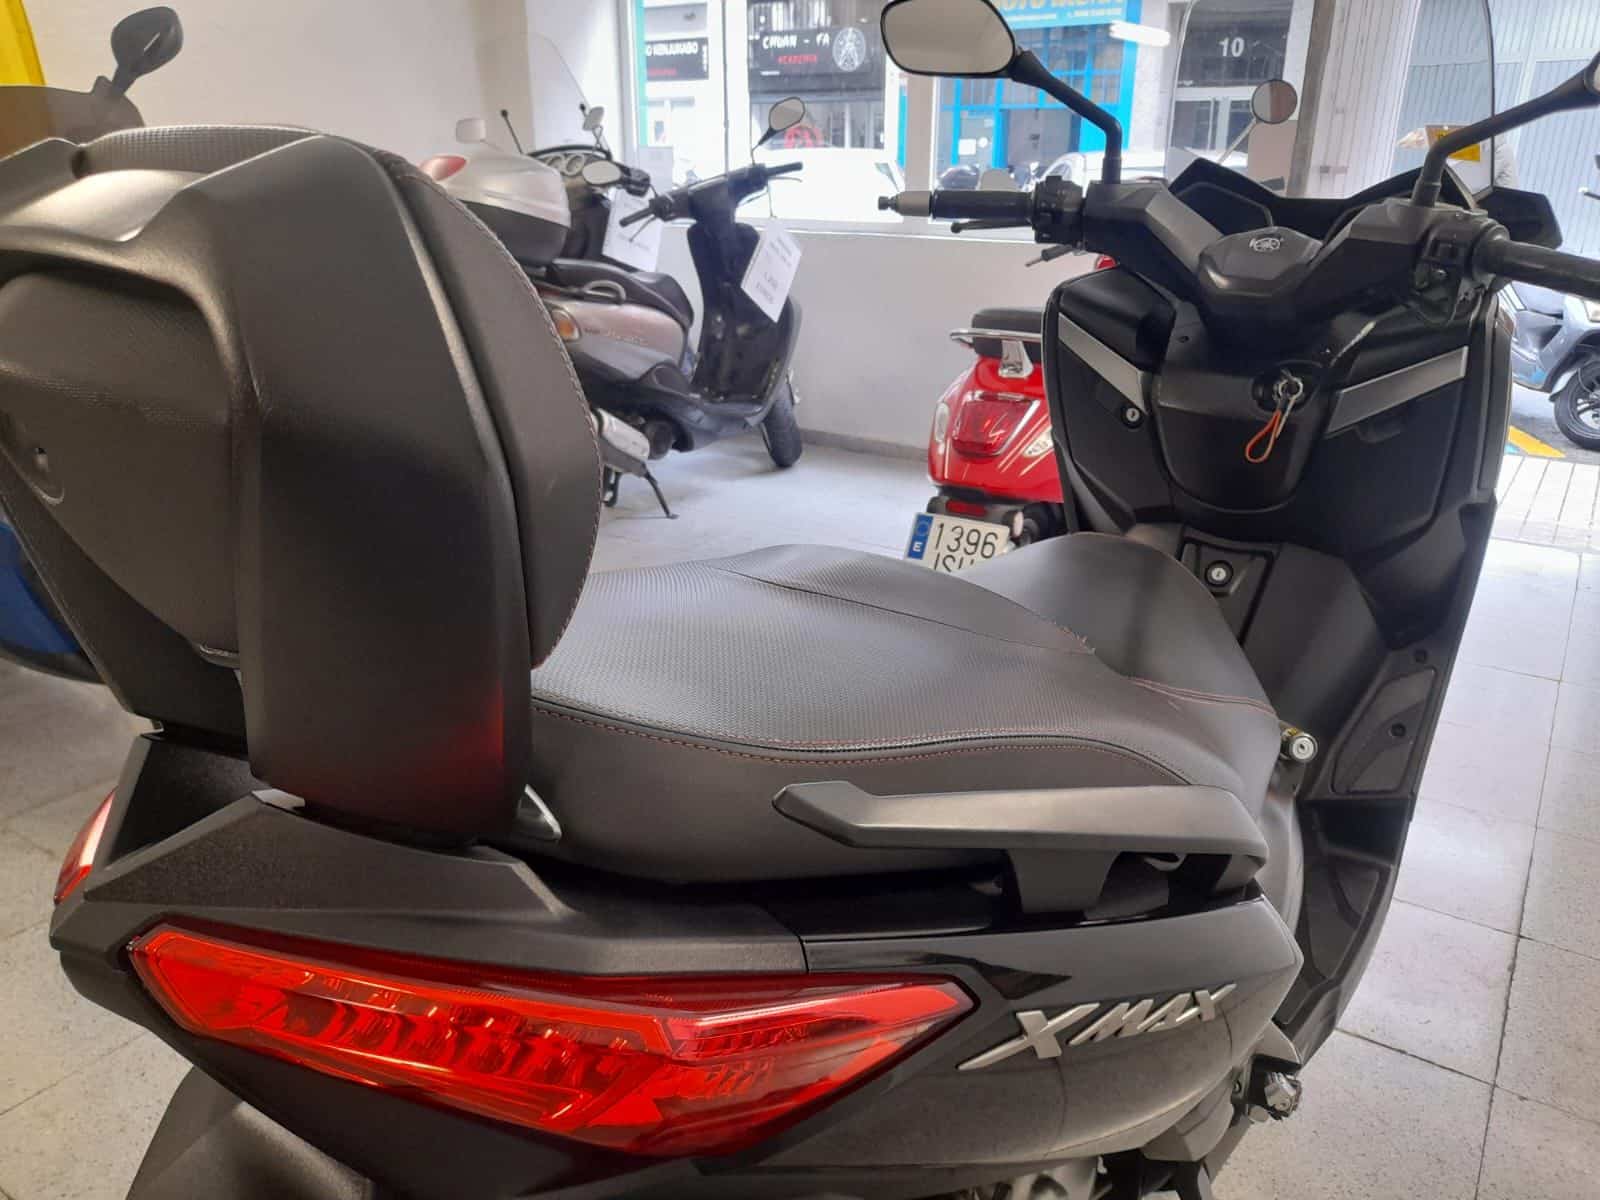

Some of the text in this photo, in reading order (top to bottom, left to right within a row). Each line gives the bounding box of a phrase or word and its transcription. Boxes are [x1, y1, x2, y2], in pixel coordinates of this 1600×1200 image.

[1218, 37, 1245, 58] 10
[912, 541, 923, 553] E
[934, 522, 999, 560] 1396
